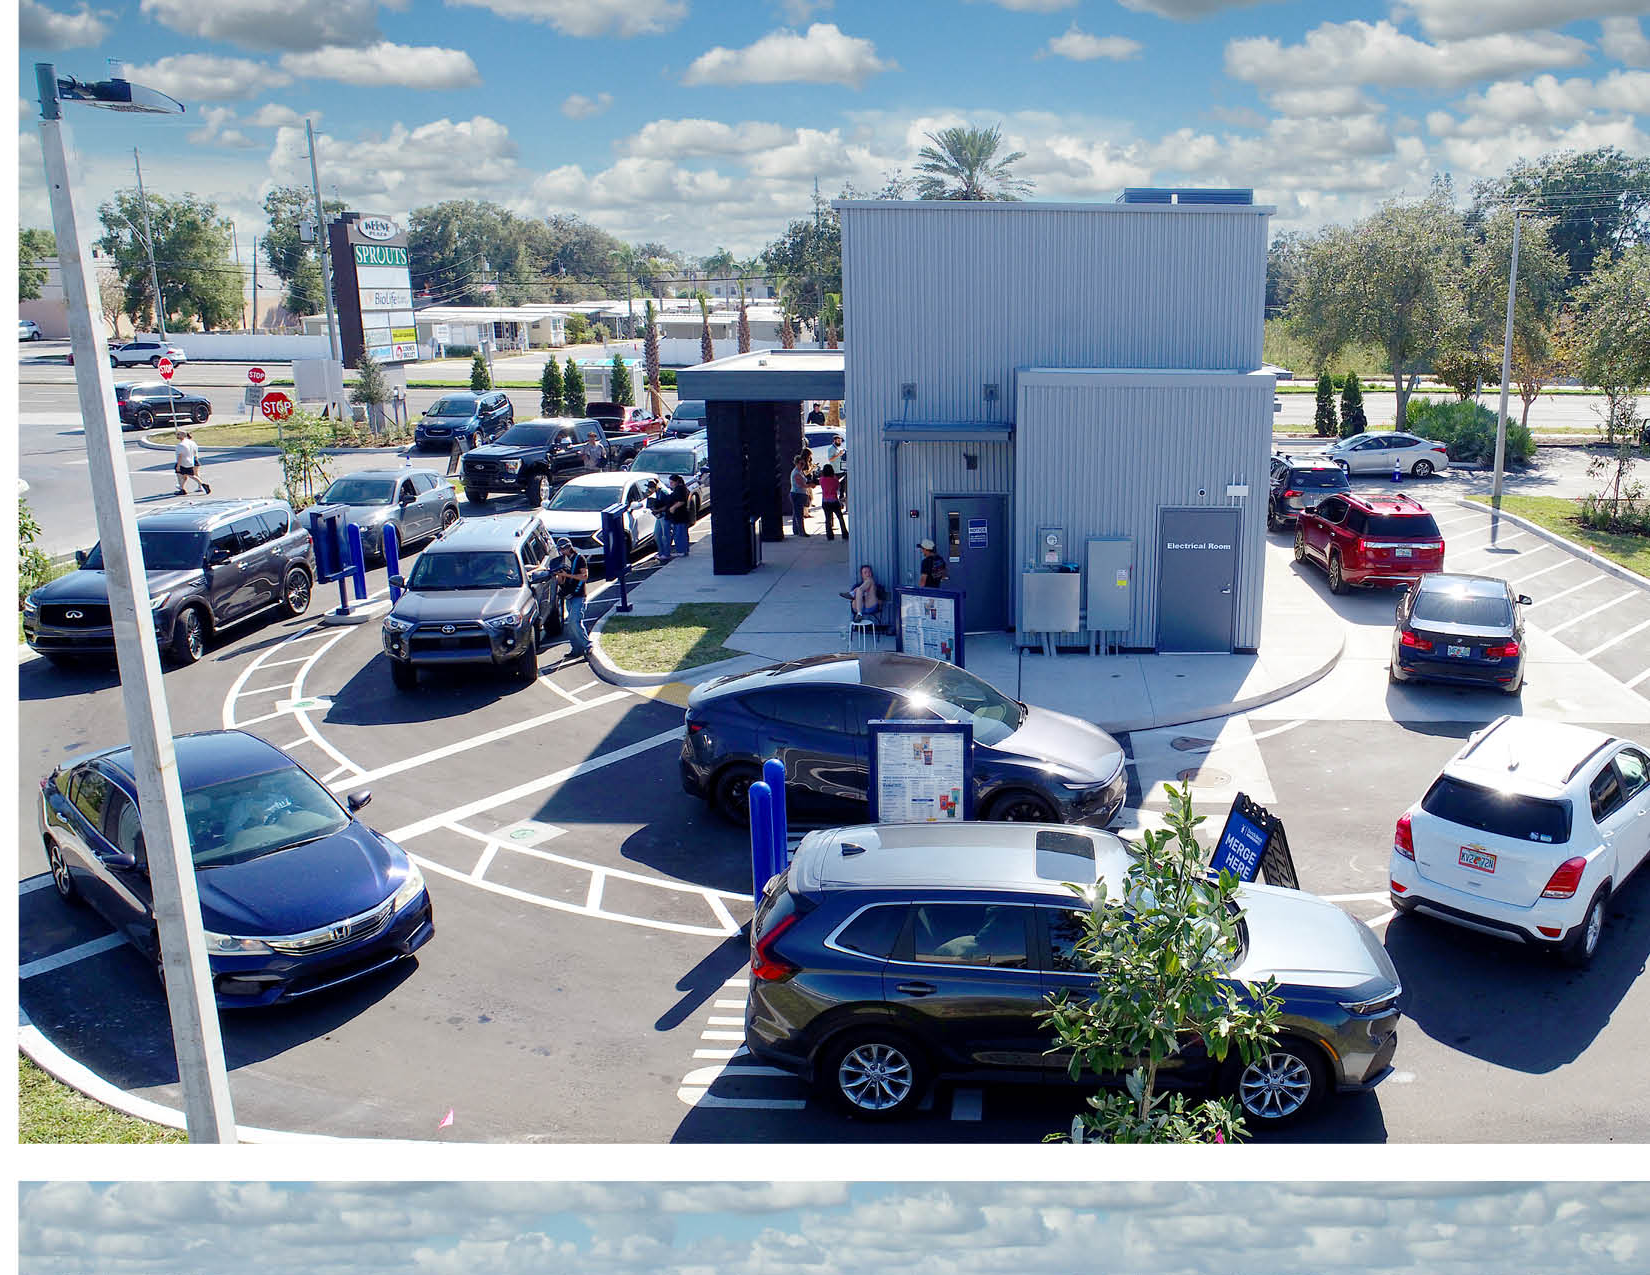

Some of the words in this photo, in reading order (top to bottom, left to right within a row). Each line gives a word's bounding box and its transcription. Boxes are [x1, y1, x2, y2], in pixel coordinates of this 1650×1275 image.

[355, 246, 408, 264] SPROUTS
[159, 365, 173, 374] STOP
[248, 371, 265, 379] STOP
[1167, 542, 1206, 550] Electrical
[1208, 542, 1231, 550] Room
[1225, 833, 1257, 866] MERGE
[1225, 852, 1251, 880] HERE
